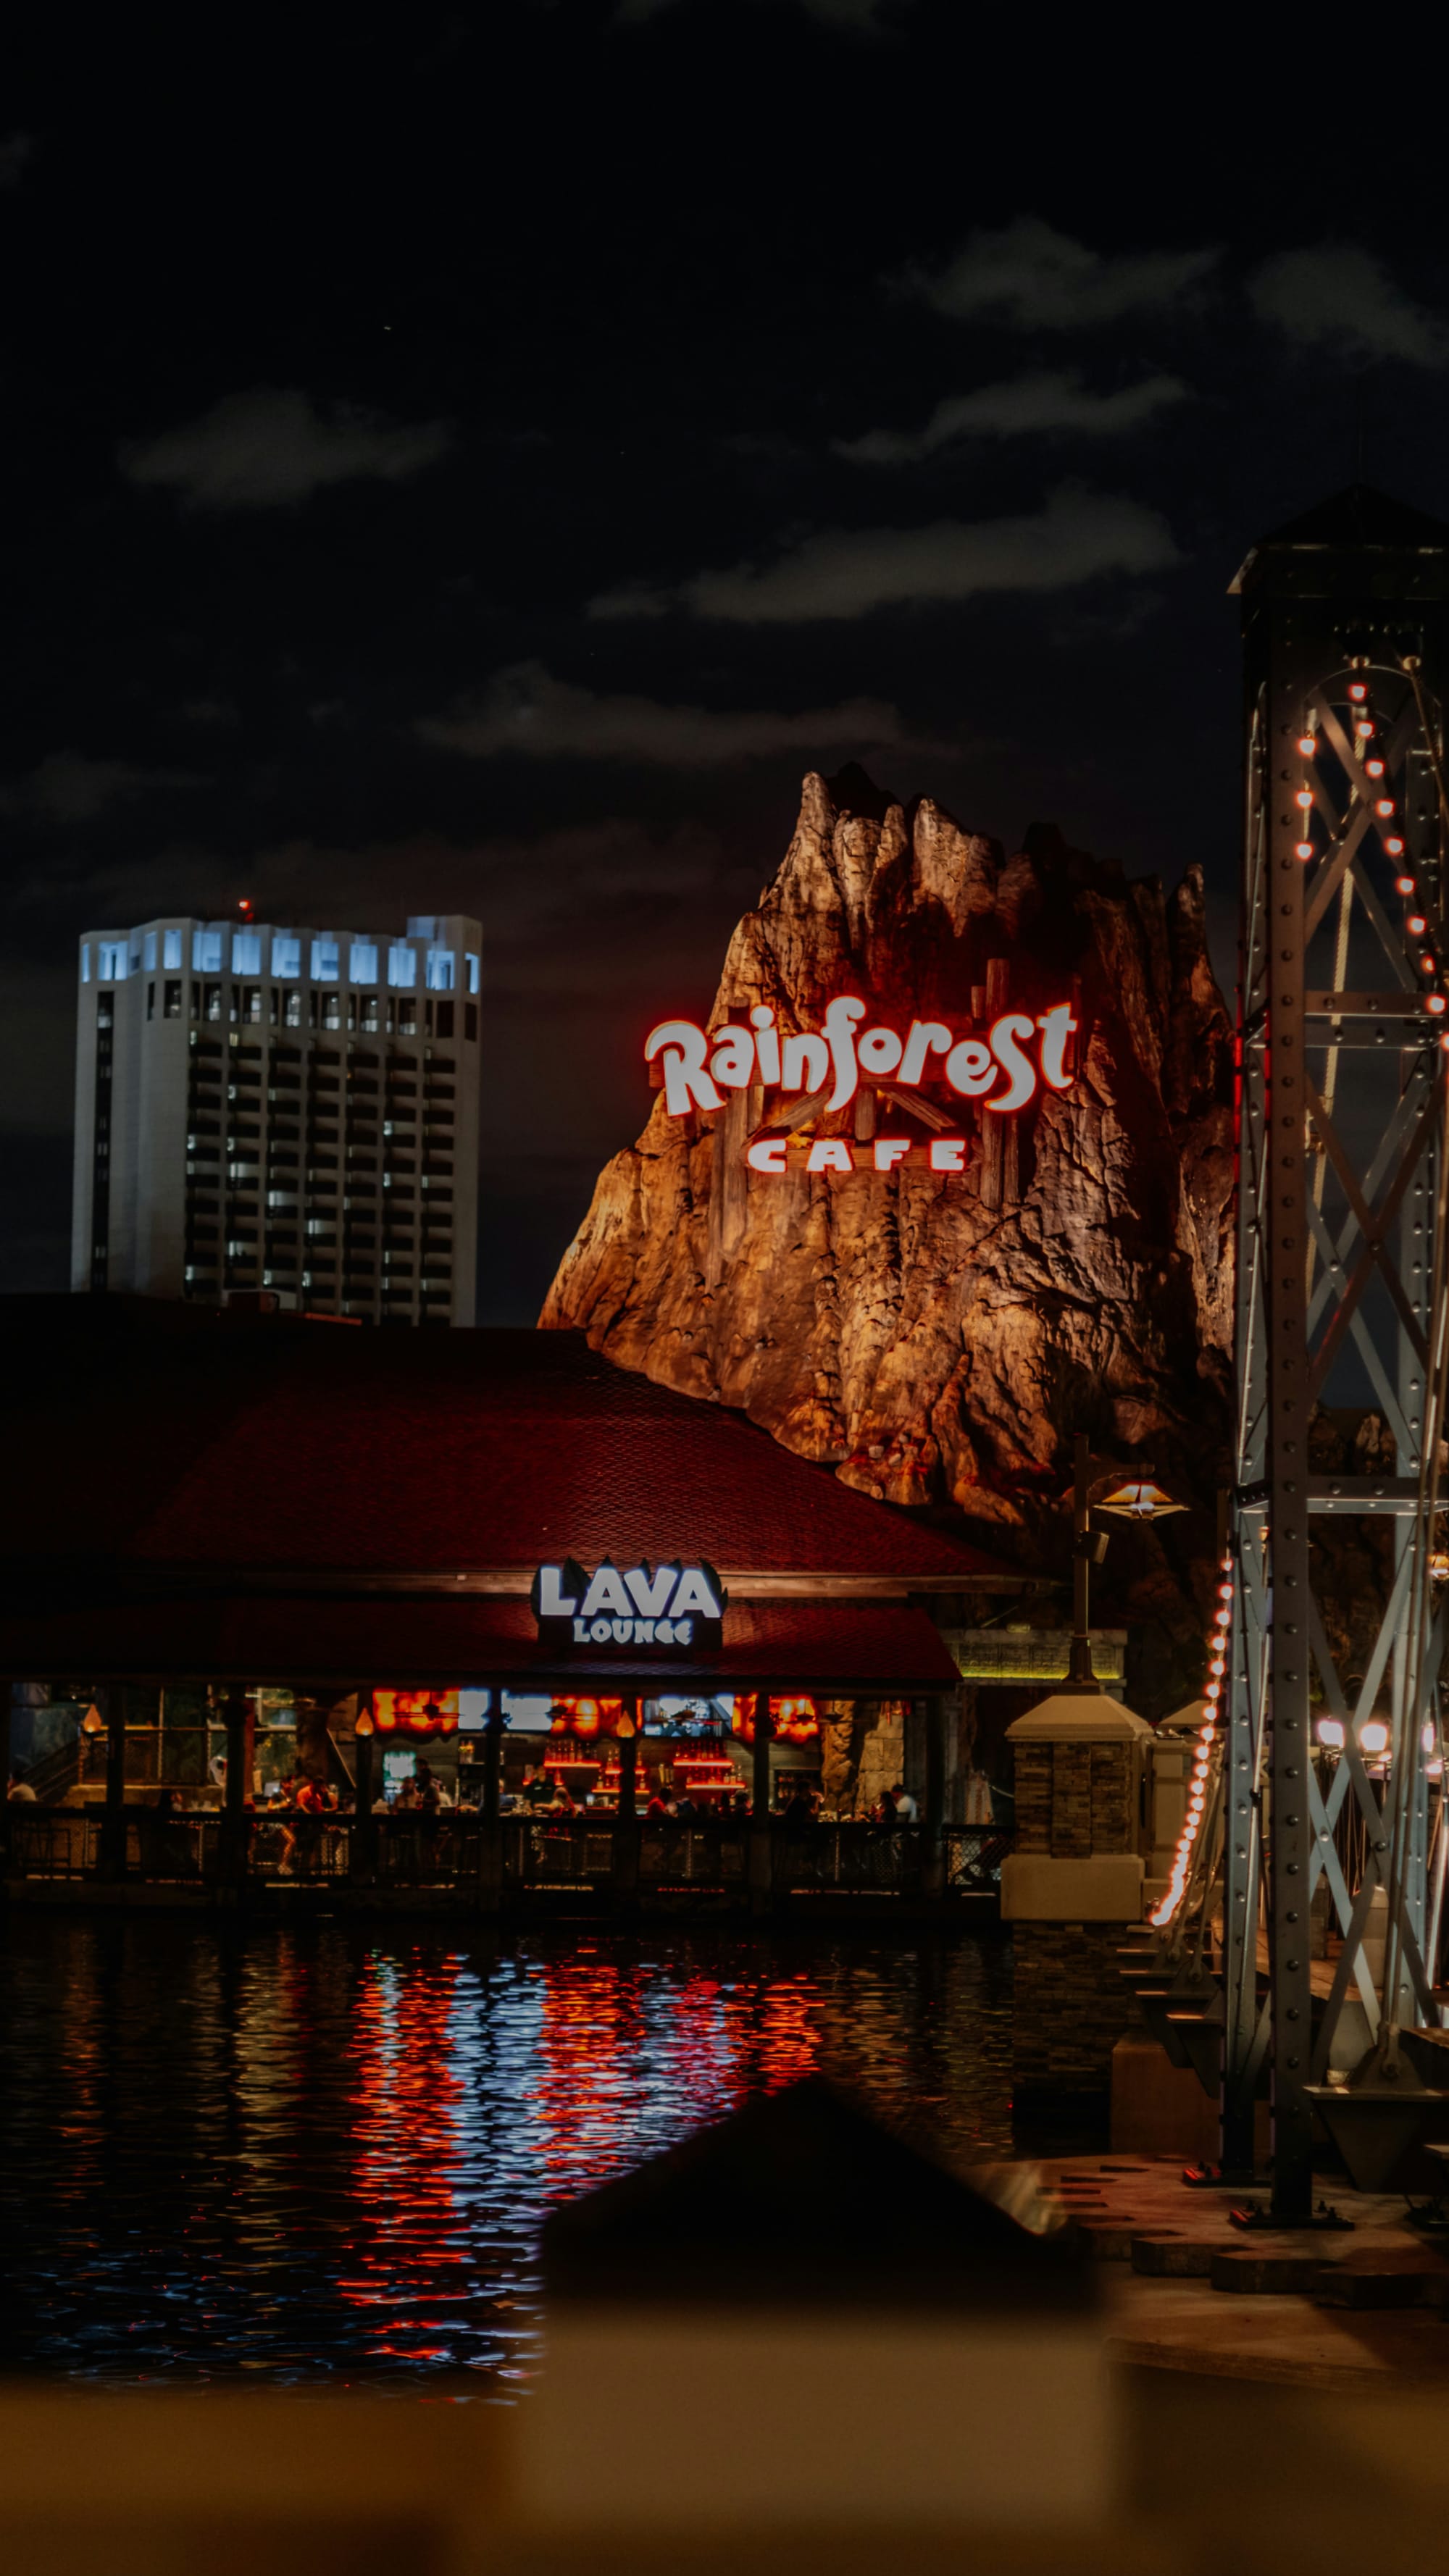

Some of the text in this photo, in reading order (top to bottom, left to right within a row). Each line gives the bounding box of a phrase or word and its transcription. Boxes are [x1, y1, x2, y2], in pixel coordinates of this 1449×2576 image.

[747, 1139, 966, 1173] CAFE
[540, 1566, 722, 1618] LAVA
[572, 1618, 693, 1645] LOUNGE
